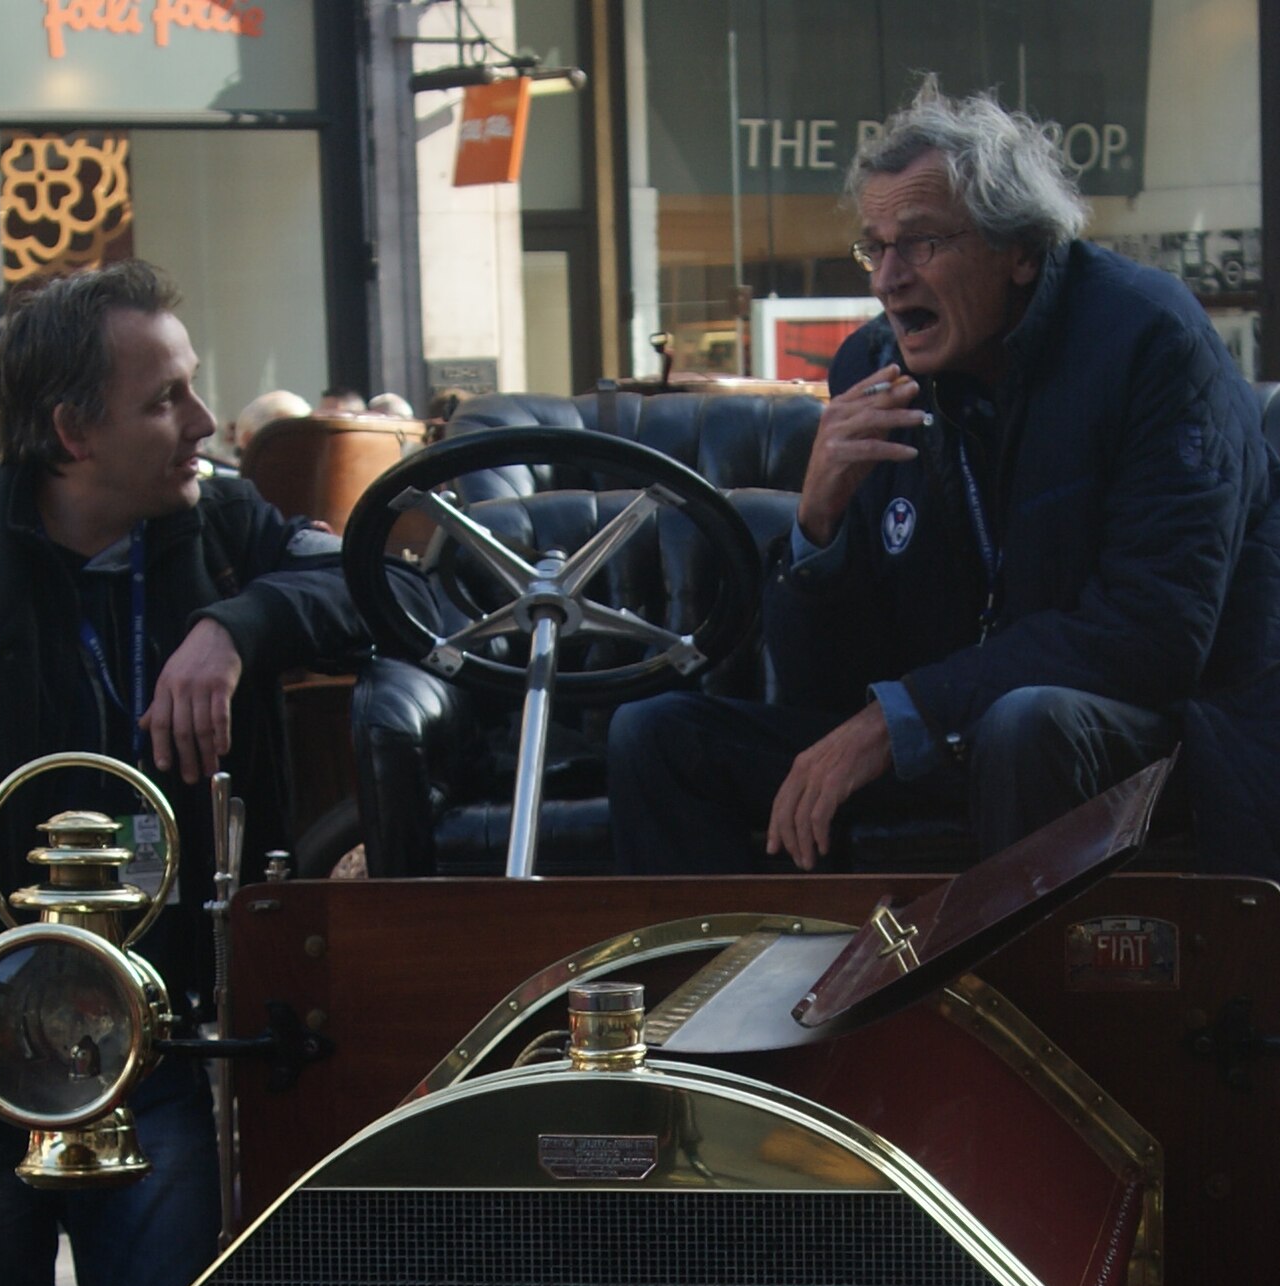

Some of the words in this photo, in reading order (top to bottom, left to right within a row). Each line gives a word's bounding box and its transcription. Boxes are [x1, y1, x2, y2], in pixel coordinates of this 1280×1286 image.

[738, 118, 837, 168] THE
[134, 634, 143, 661] ROYAL
[134, 665, 143, 718] AUTOMOBIL
[1097, 935, 1147, 966] FIAT
